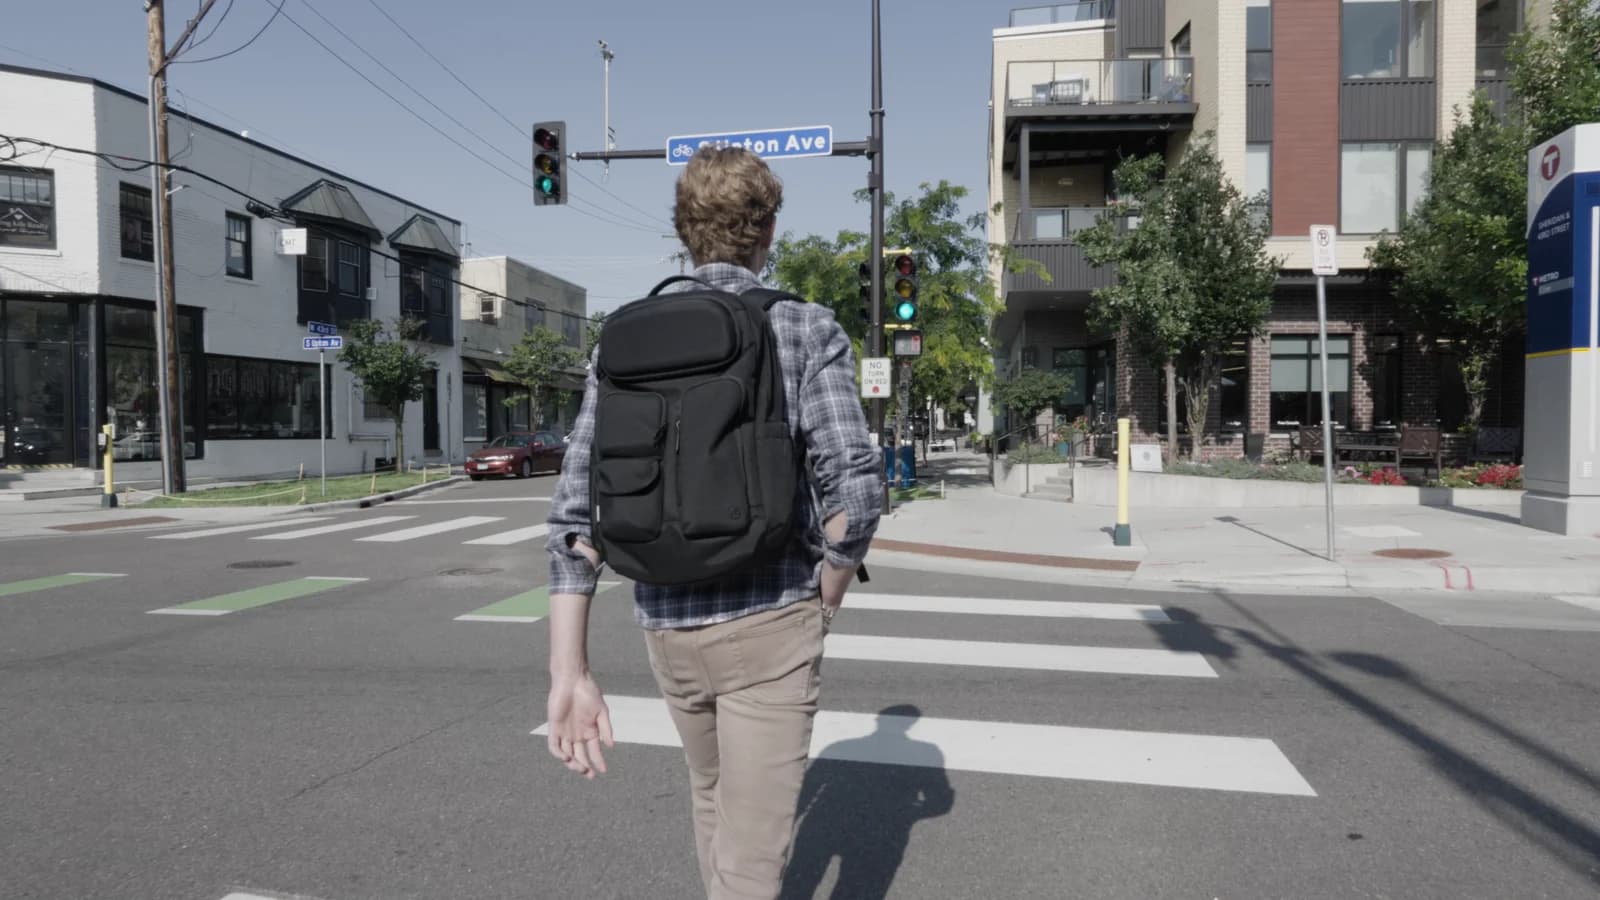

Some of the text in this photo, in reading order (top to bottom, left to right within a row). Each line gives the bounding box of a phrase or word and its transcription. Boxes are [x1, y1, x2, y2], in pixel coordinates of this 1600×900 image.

[785, 134, 825, 151] Ave
[1551, 222, 1570, 236] STREET
[1539, 271, 1560, 283] METRO
[869, 361, 882, 369] NO
